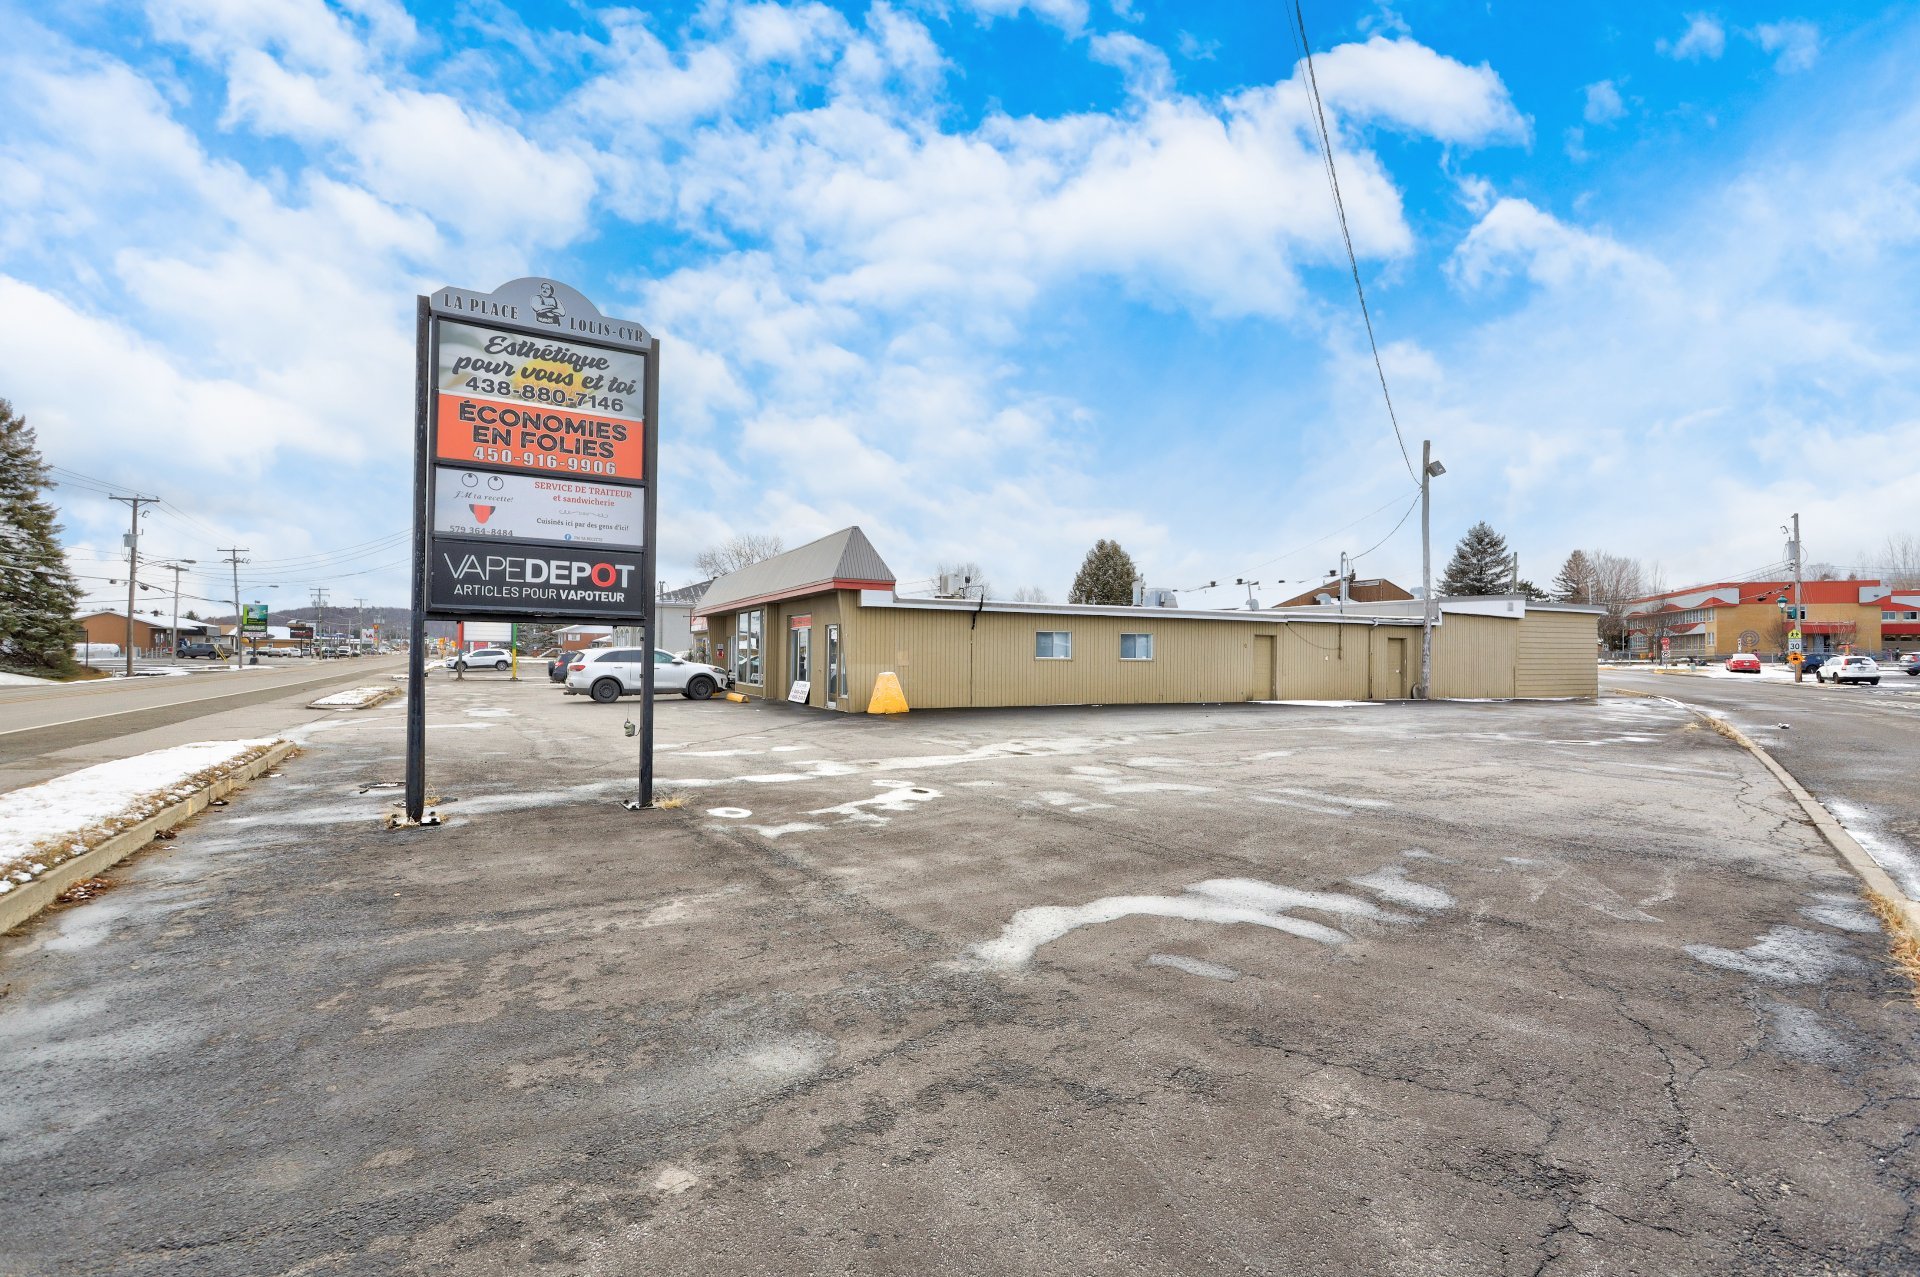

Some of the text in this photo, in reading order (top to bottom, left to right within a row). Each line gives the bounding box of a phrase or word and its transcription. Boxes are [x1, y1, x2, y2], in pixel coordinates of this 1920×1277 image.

[444, 293, 518, 320] LA PLACE
[570, 317, 643, 342] LOUIS-CYR
[484, 335, 610, 372] Esthétique
[452, 356, 637, 396] pour vous et toi
[465, 376, 624, 412] 438-880-7146
[459, 400, 627, 442] ÉCONOMIES
[473, 424, 614, 459] EN FOLIES
[473, 446, 617, 475] 450-916-9906
[534, 481, 632, 499] SERVICE DE TRAITEUR
[552, 494, 615, 507] et sandwicherie
[574, 521, 585, 529] par
[586, 521, 597, 529] des
[453, 584, 625, 603] ARTICLES POUR VAPOTEUR
